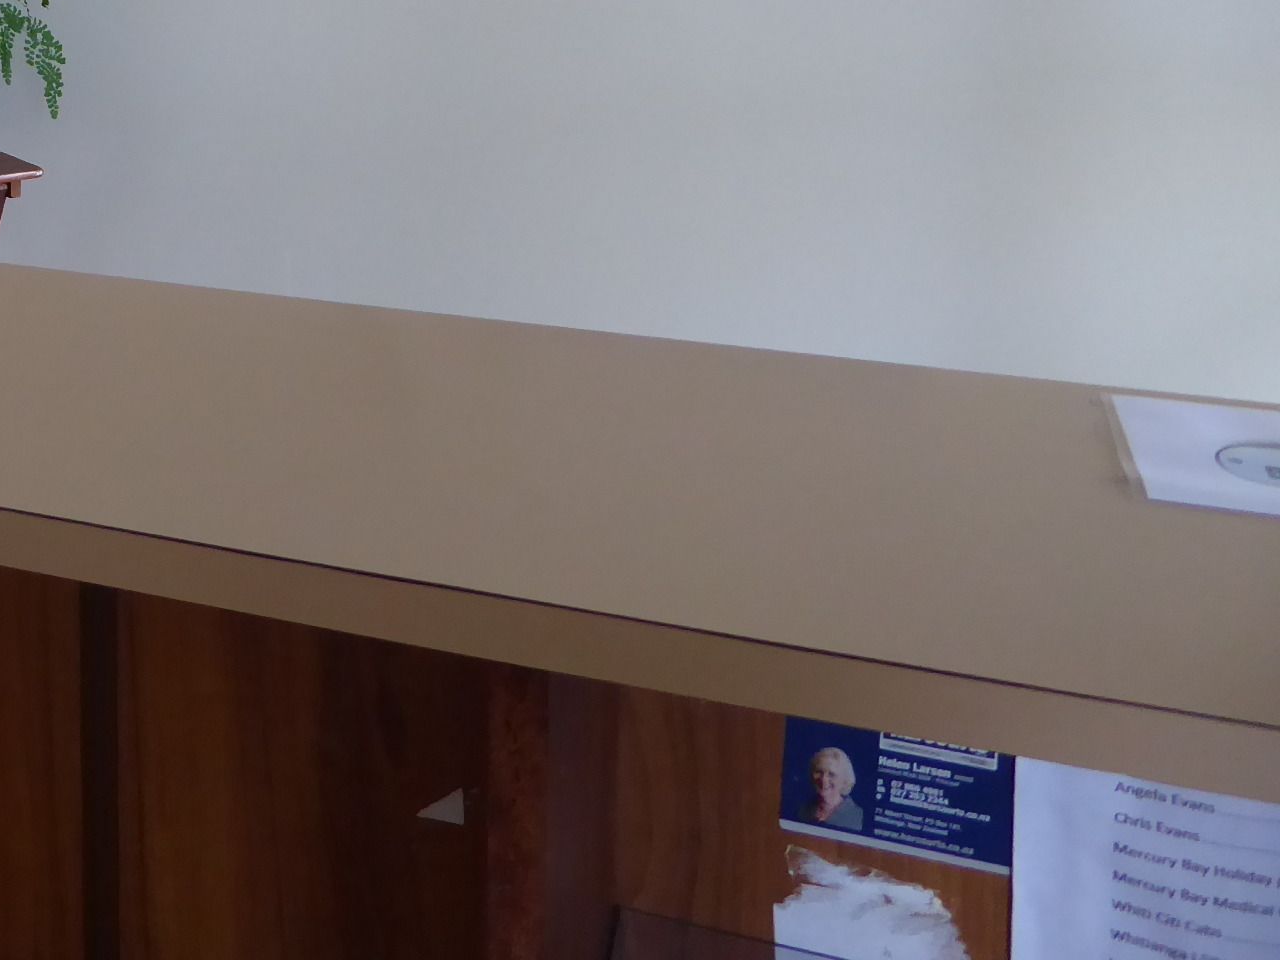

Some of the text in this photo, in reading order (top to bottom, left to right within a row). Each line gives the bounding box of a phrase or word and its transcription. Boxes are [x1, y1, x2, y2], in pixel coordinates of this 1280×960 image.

[878, 754, 911, 770] Helen
[1115, 781, 1216, 814] Angela Evans
[1114, 812, 1201, 842] Chris Evans
[1113, 841, 1273, 887] Mercury Bay Holiday
[1112, 870, 1275, 917] Mercury Bay Medical
[1110, 928, 1188, 960] Whitianga
